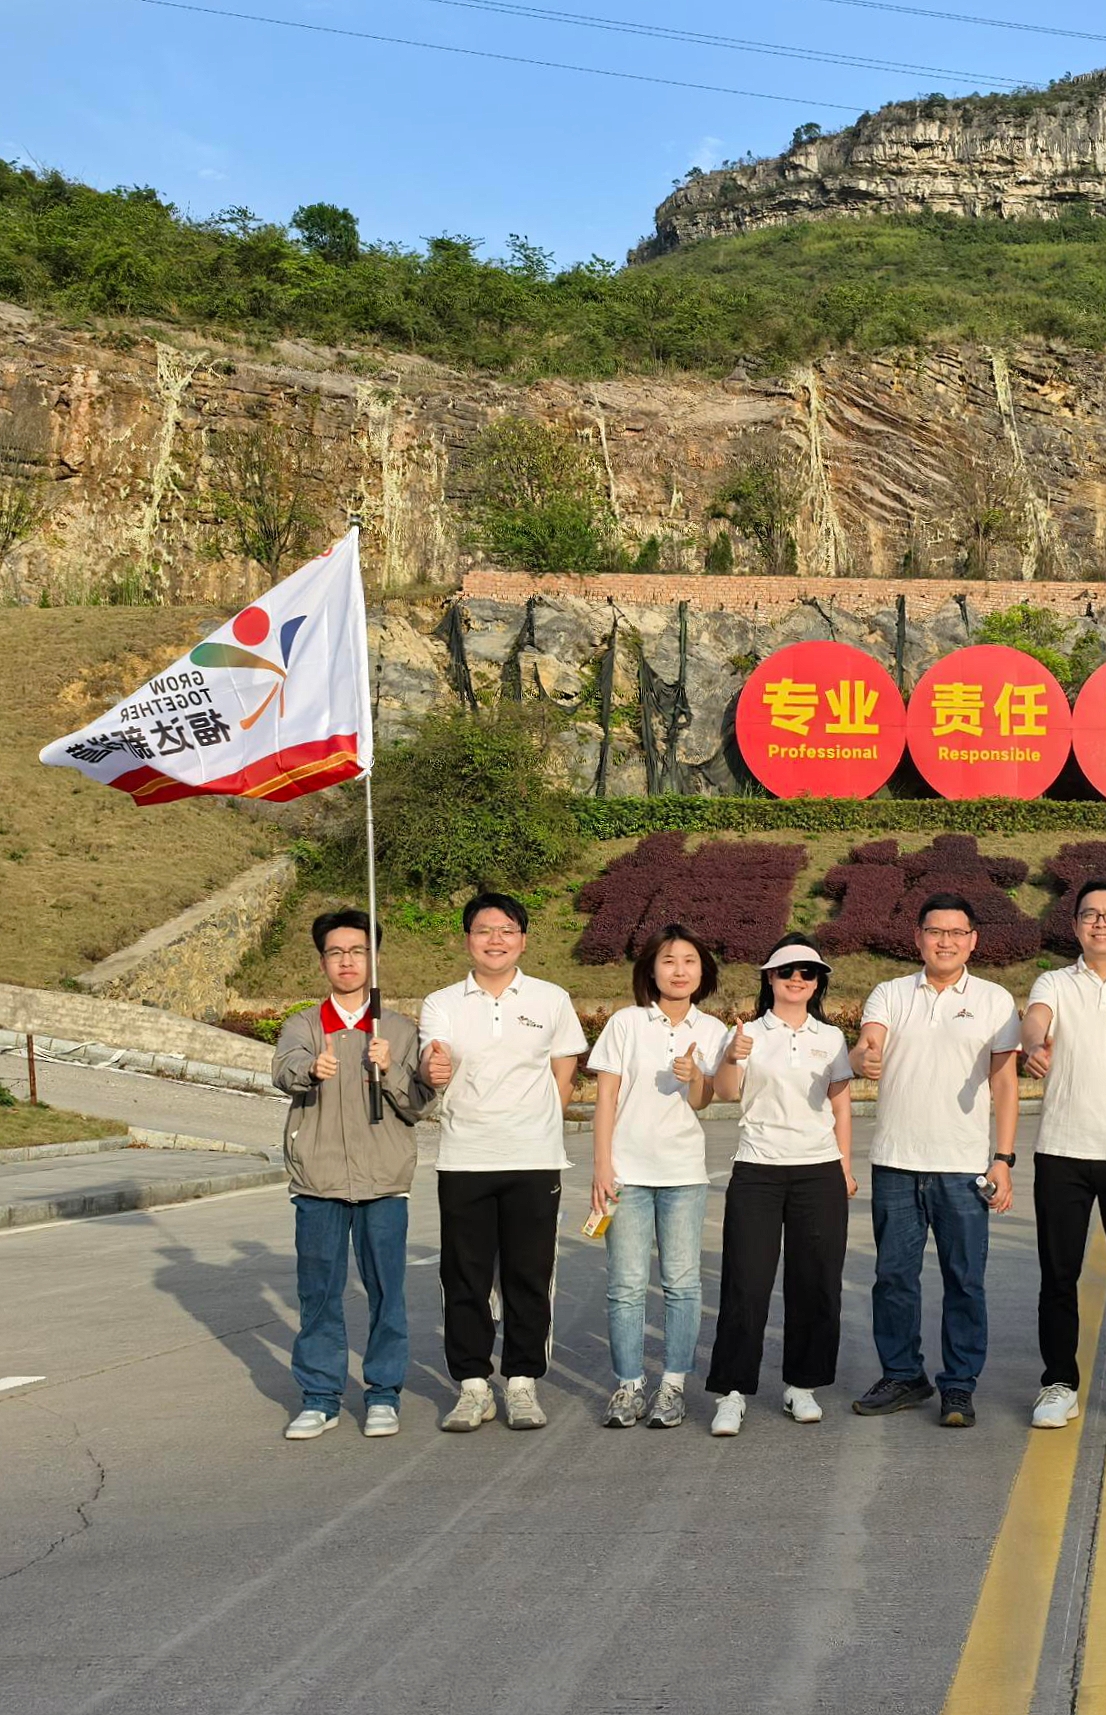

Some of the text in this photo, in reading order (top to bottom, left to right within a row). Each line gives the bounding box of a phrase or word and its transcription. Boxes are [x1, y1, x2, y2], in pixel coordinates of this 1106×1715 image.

[763, 678, 879, 736] 专业
[931, 682, 1048, 737] 责任
[768, 743, 878, 760] Professional
[938, 746, 1041, 764] Responsible
